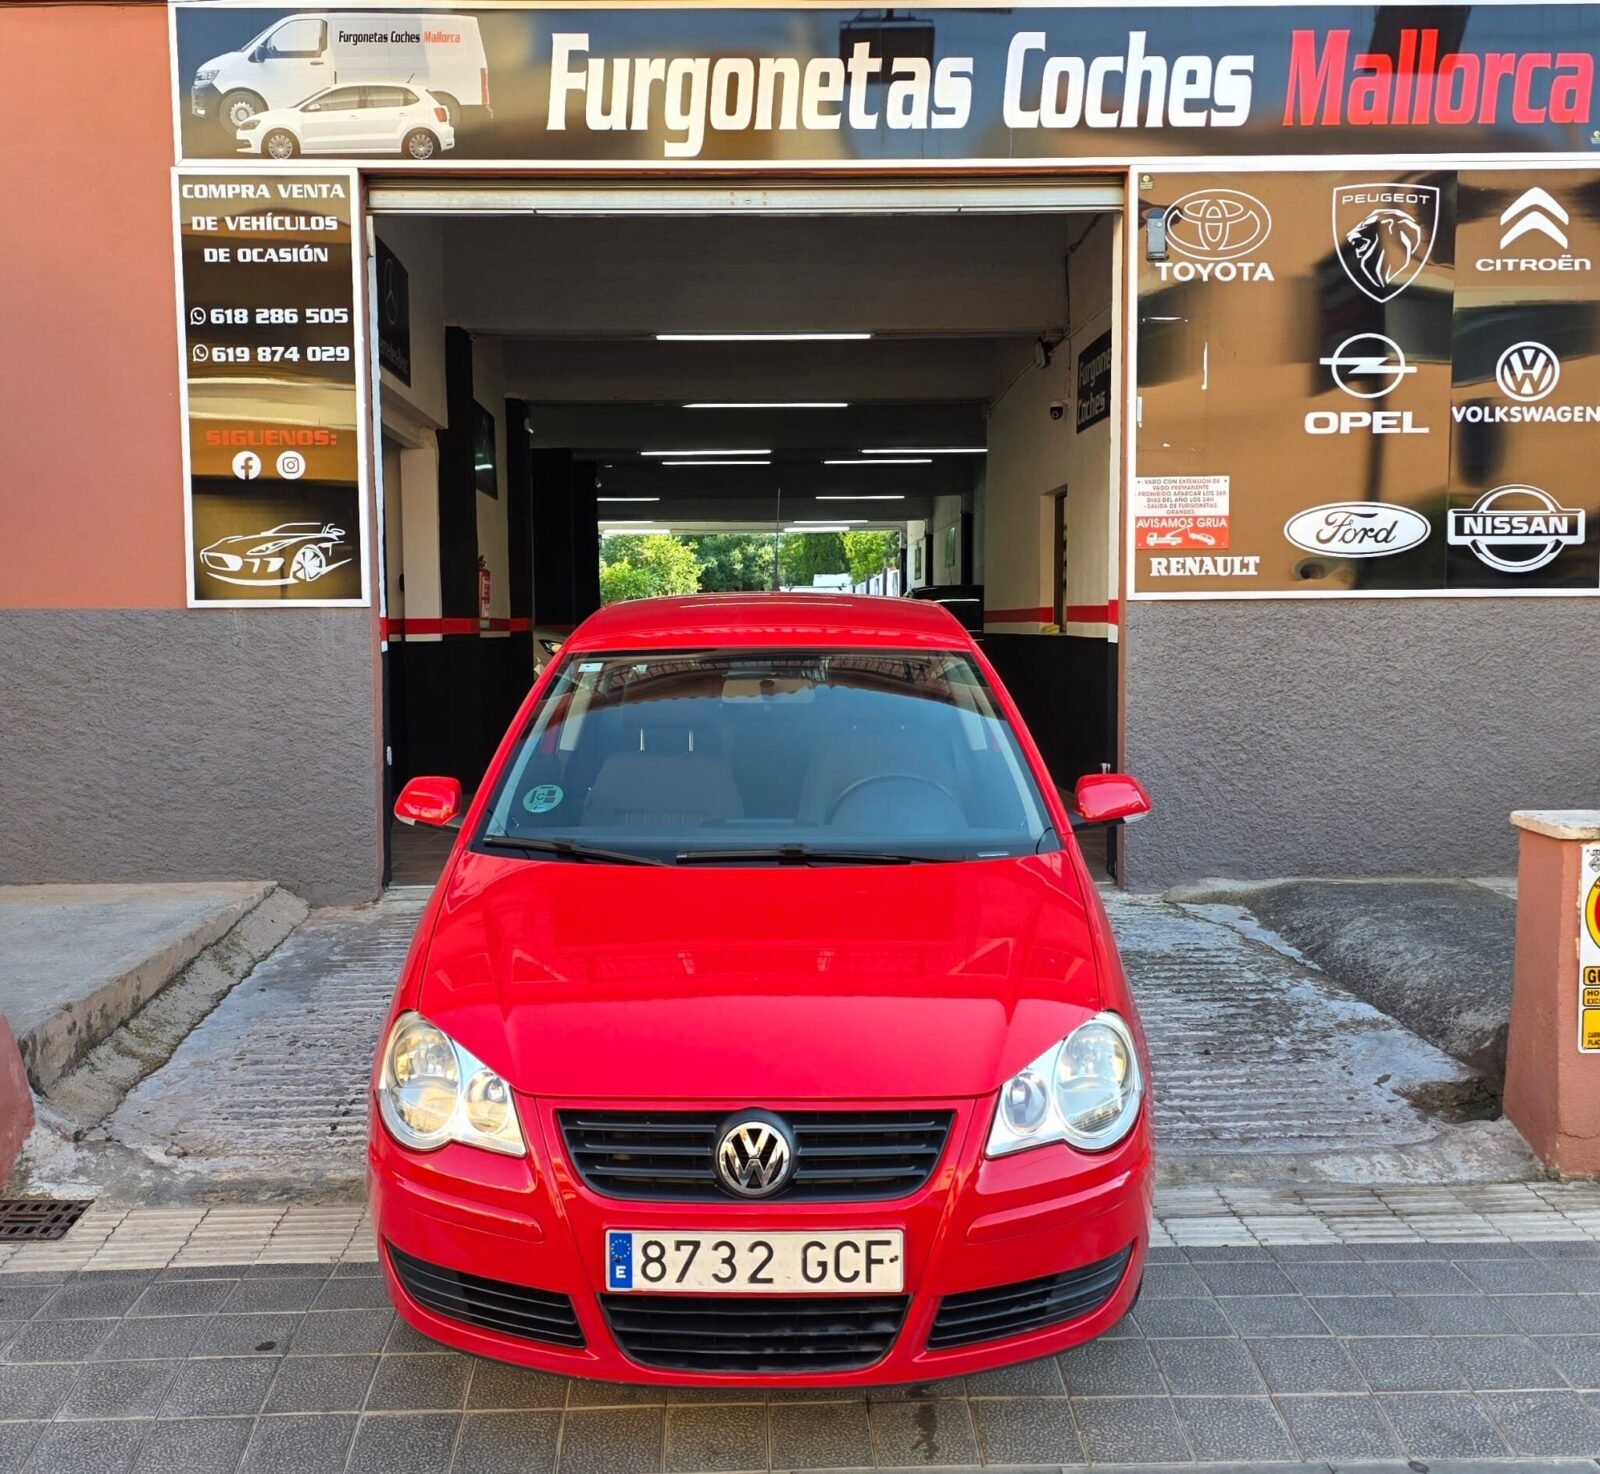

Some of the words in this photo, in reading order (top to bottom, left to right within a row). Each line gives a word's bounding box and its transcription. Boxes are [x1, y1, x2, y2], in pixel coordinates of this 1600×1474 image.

[338, 31, 388, 45] Furgonetas
[391, 31, 420, 43] Coches
[424, 31, 461, 44] Mallorca
[546, 33, 974, 157] Furgonetas
[1003, 31, 1254, 129] Coches
[1282, 29, 1594, 126] Mallorca
[182, 184, 271, 199] COMPRA
[277, 183, 346, 199] VENTA
[1342, 193, 1431, 205] PEUGEOT
[191, 216, 218, 231] DE
[224, 212, 339, 231] VEHÍCULOS
[204, 248, 231, 262] DE
[237, 244, 329, 262] OCASIÓN
[1155, 261, 1275, 282] TOYOTA
[210, 308, 249, 324] 618
[255, 308, 299, 324] 286
[305, 308, 349, 324] 505
[211, 347, 250, 362] 619
[257, 347, 300, 362] 874
[306, 346, 350, 362] 029
[1304, 411, 1430, 434] OPEL
[1451, 405, 1600, 423] VOLKSWAGEN
[206, 430, 338, 446] SIGUENOS:
[1136, 517, 1193, 528] AVISAMOS
[1196, 517, 1228, 527] GRUA
[1315, 511, 1399, 545] Ford
[1463, 516, 1569, 535] NISSAN
[1149, 555, 1260, 576] RENAULT
[615, 1266, 627, 1278] E
[641, 1240, 774, 1283] 8732
[801, 1240, 892, 1283] GCF
